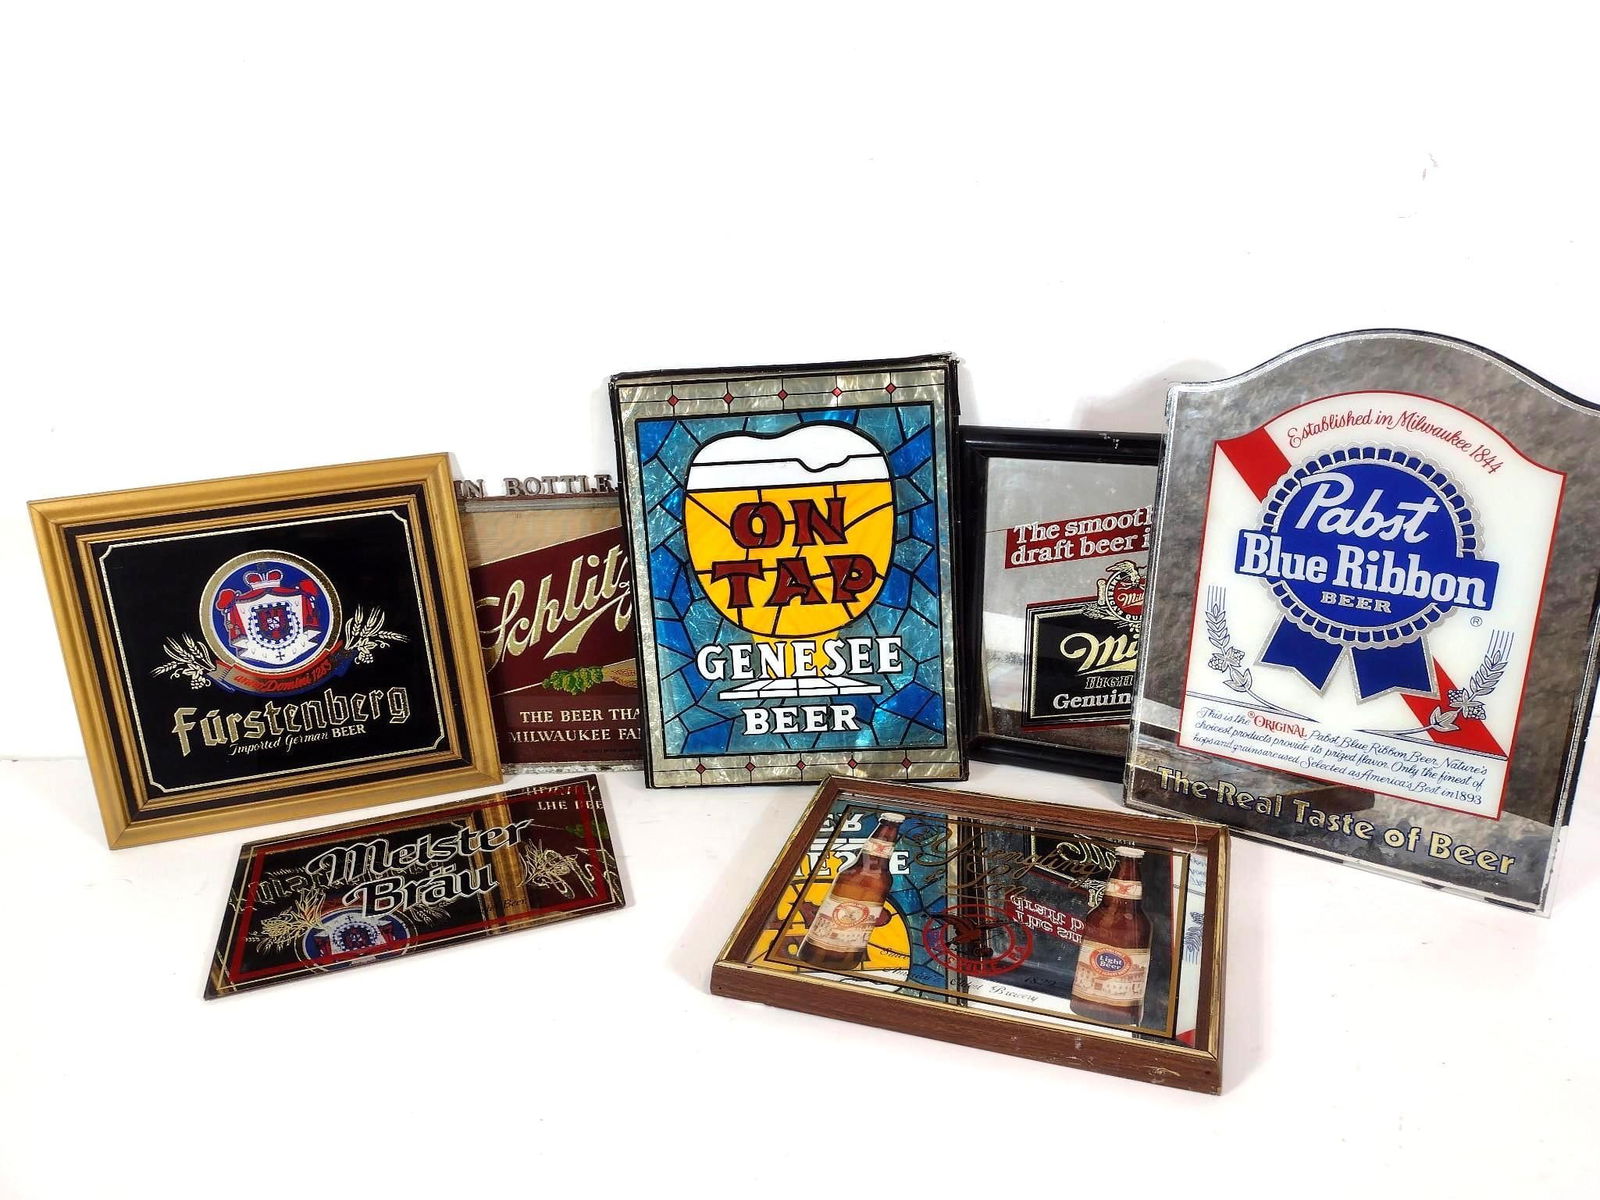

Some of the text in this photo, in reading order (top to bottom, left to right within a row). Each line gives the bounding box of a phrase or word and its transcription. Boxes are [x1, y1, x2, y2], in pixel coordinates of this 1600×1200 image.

[1287, 409, 1504, 475] Established in Milwaukee 1844
[729, 497, 846, 549] ON
[1295, 471, 1441, 544] Pabst
[1011, 542, 1076, 566] draft
[1080, 532, 1141, 557] beer
[1012, 522, 1061, 545] The
[710, 555, 879, 609] TAP
[1239, 531, 1487, 608] Blue Ribbon
[1320, 591, 1393, 613] BEER
[695, 636, 904, 681] GENESEE
[228, 723, 367, 756] Imported German BEER
[508, 728, 611, 743] MILWAUKEE
[519, 710, 554, 724] THE
[560, 708, 604, 723] BEER
[743, 704, 861, 736] BEER
[1193, 720, 1231, 735] choicest
[1230, 728, 1272, 744] products
[1271, 736, 1310, 752] provide
[1310, 744, 1322, 755] its
[1323, 747, 1357, 763] prized
[1390, 761, 1419, 778] Only
[1420, 767, 1438, 779] the
[1437, 771, 1472, 787] finest
[1472, 778, 1486, 792] of
[1196, 706, 1223, 721] This
[1223, 712, 1234, 723] is
[1234, 714, 1251, 726] the
[1253, 715, 1308, 739] ORIGINAL
[1306, 729, 1339, 745] Pabst
[1339, 736, 1368, 750] Blue
[1368, 742, 1408, 759] Ribbon
[1435, 757, 1488, 776] Nature's
[1192, 733, 1214, 746] hops
[1213, 738, 1232, 750] and
[1231, 741, 1263, 755] grains
[1277, 753, 1300, 764] used
[1299, 755, 1348, 775] Selected
[1348, 769, 1361, 779] as
[1358, 768, 1413, 791] America's
[1411, 781, 1440, 795] Best
[1441, 789, 1455, 798] in
[1455, 790, 1482, 805] 1893
[1156, 765, 1516, 875] The Real Taste of Beer
[305, 819, 535, 885] Meister
[342, 864, 502, 919] Bräu
[1099, 954, 1123, 966] Light
[1099, 960, 1122, 970] Beer
[990, 983, 1039, 1002] Brewery
